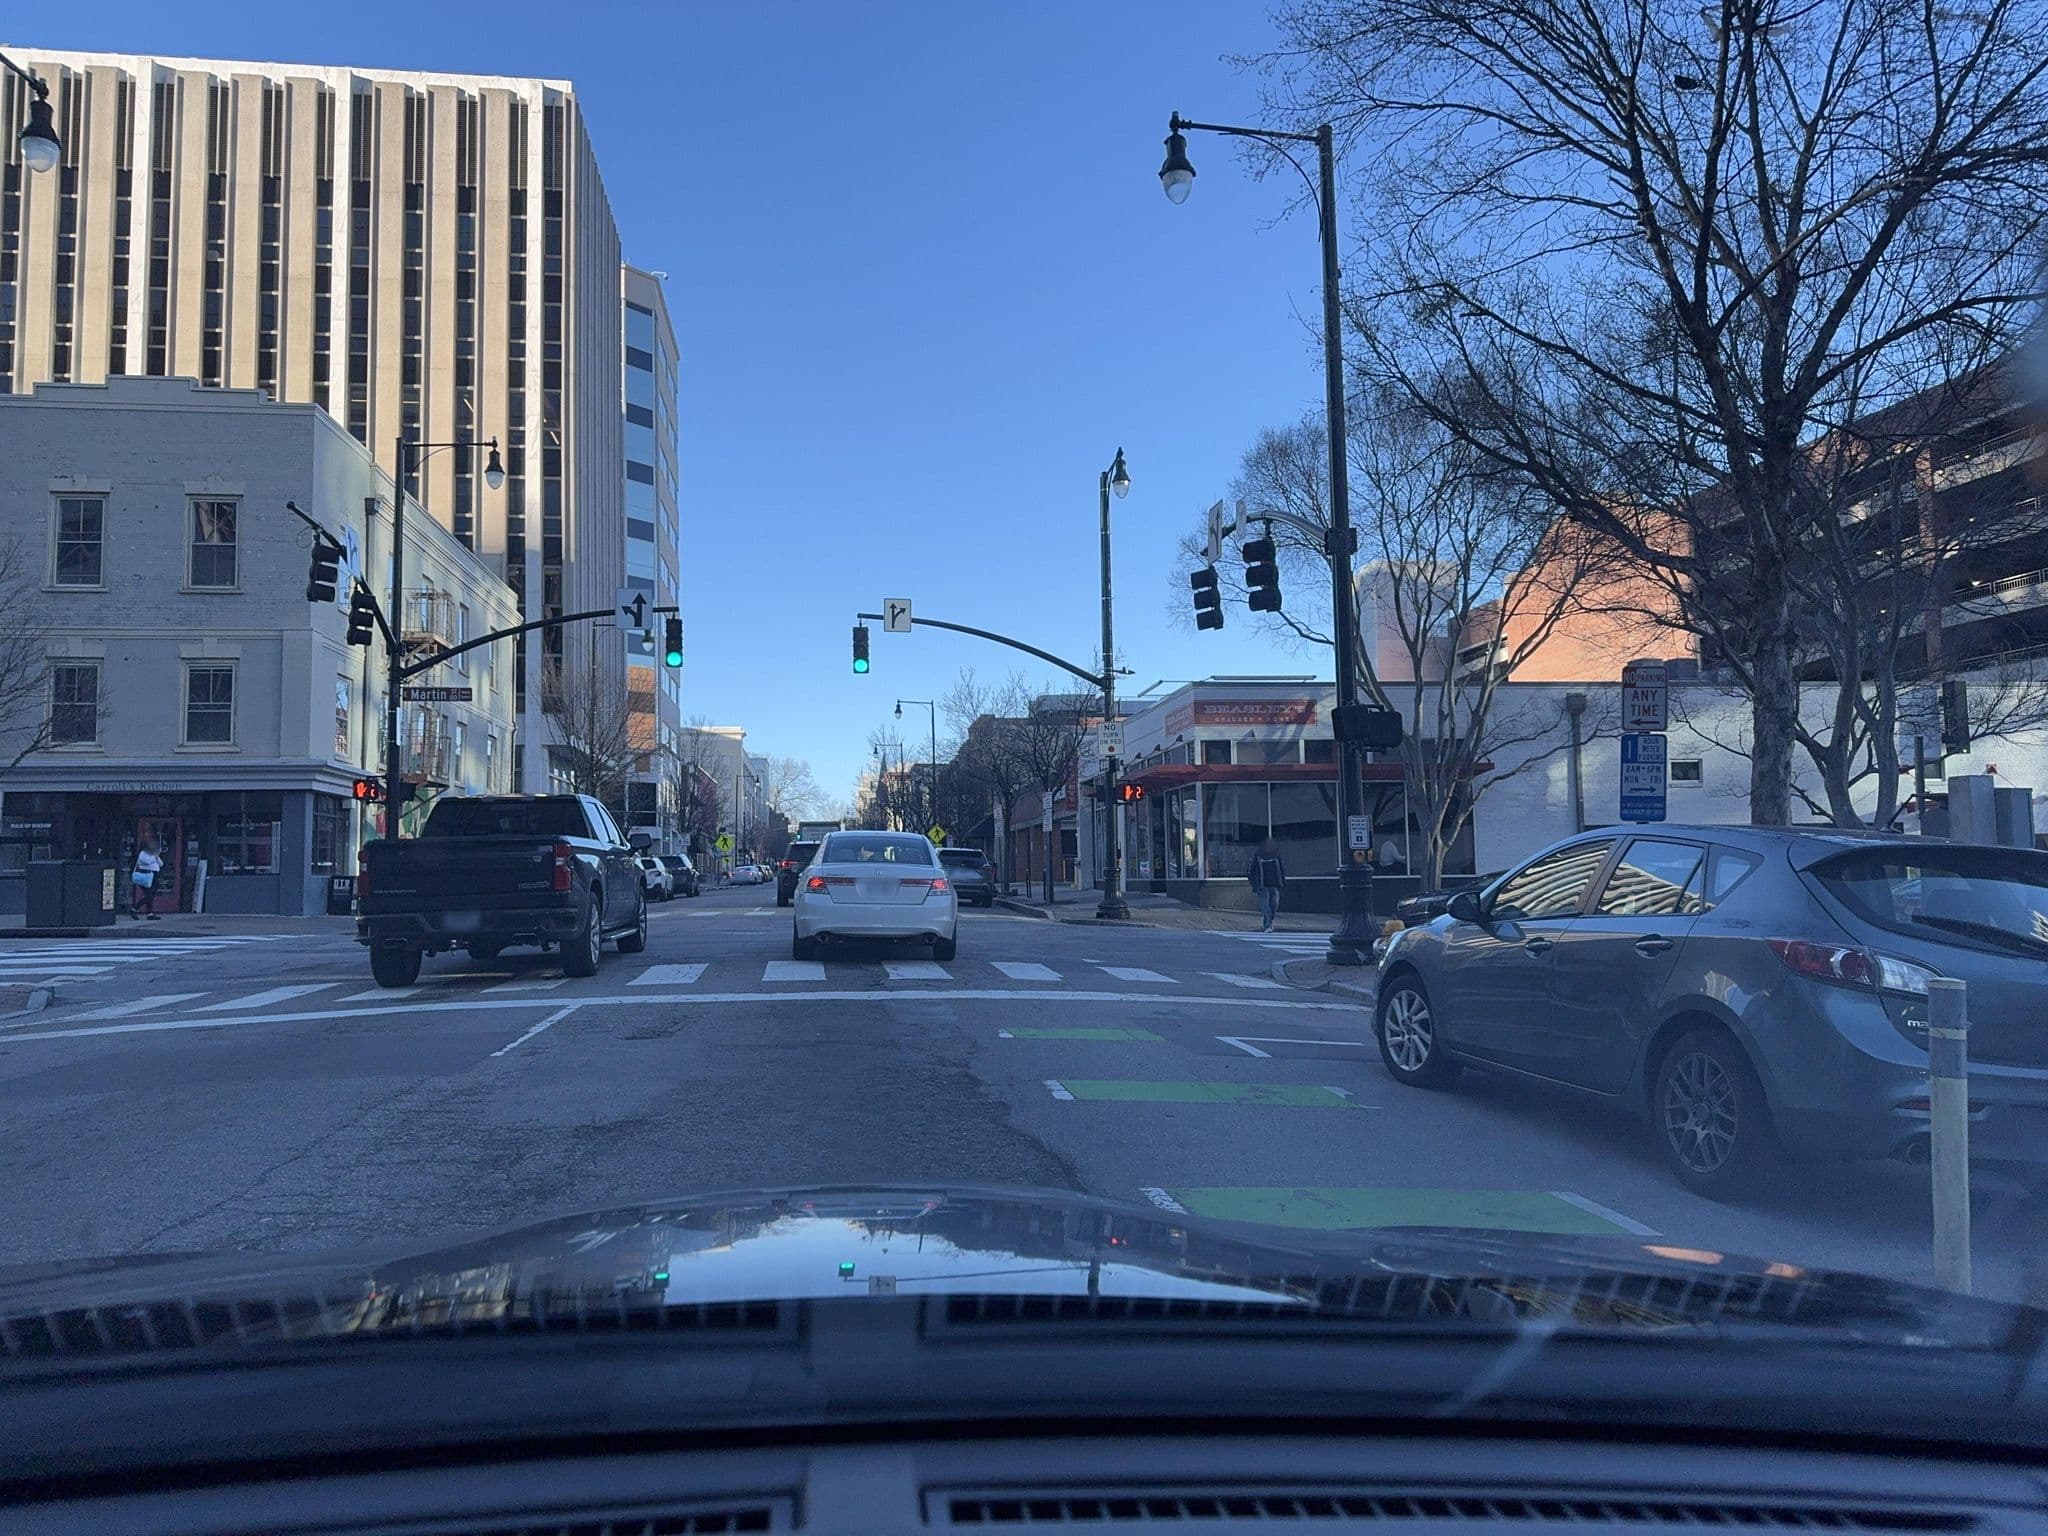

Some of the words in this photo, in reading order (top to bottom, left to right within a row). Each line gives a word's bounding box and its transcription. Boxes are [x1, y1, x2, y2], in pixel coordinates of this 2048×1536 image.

[1624, 670, 1636, 684] NO
[1637, 673, 1665, 681] PARKING
[411, 688, 447, 700] Martin
[1632, 690, 1658, 702] ANY
[1204, 704, 1306, 714] BEASLEY'S
[1632, 704, 1659, 717] TIME
[1624, 775, 1640, 784] MON
[1650, 775, 1662, 784] FRI
[86, 782, 136, 792] Carroll's
[140, 782, 181, 791] Kitchen
